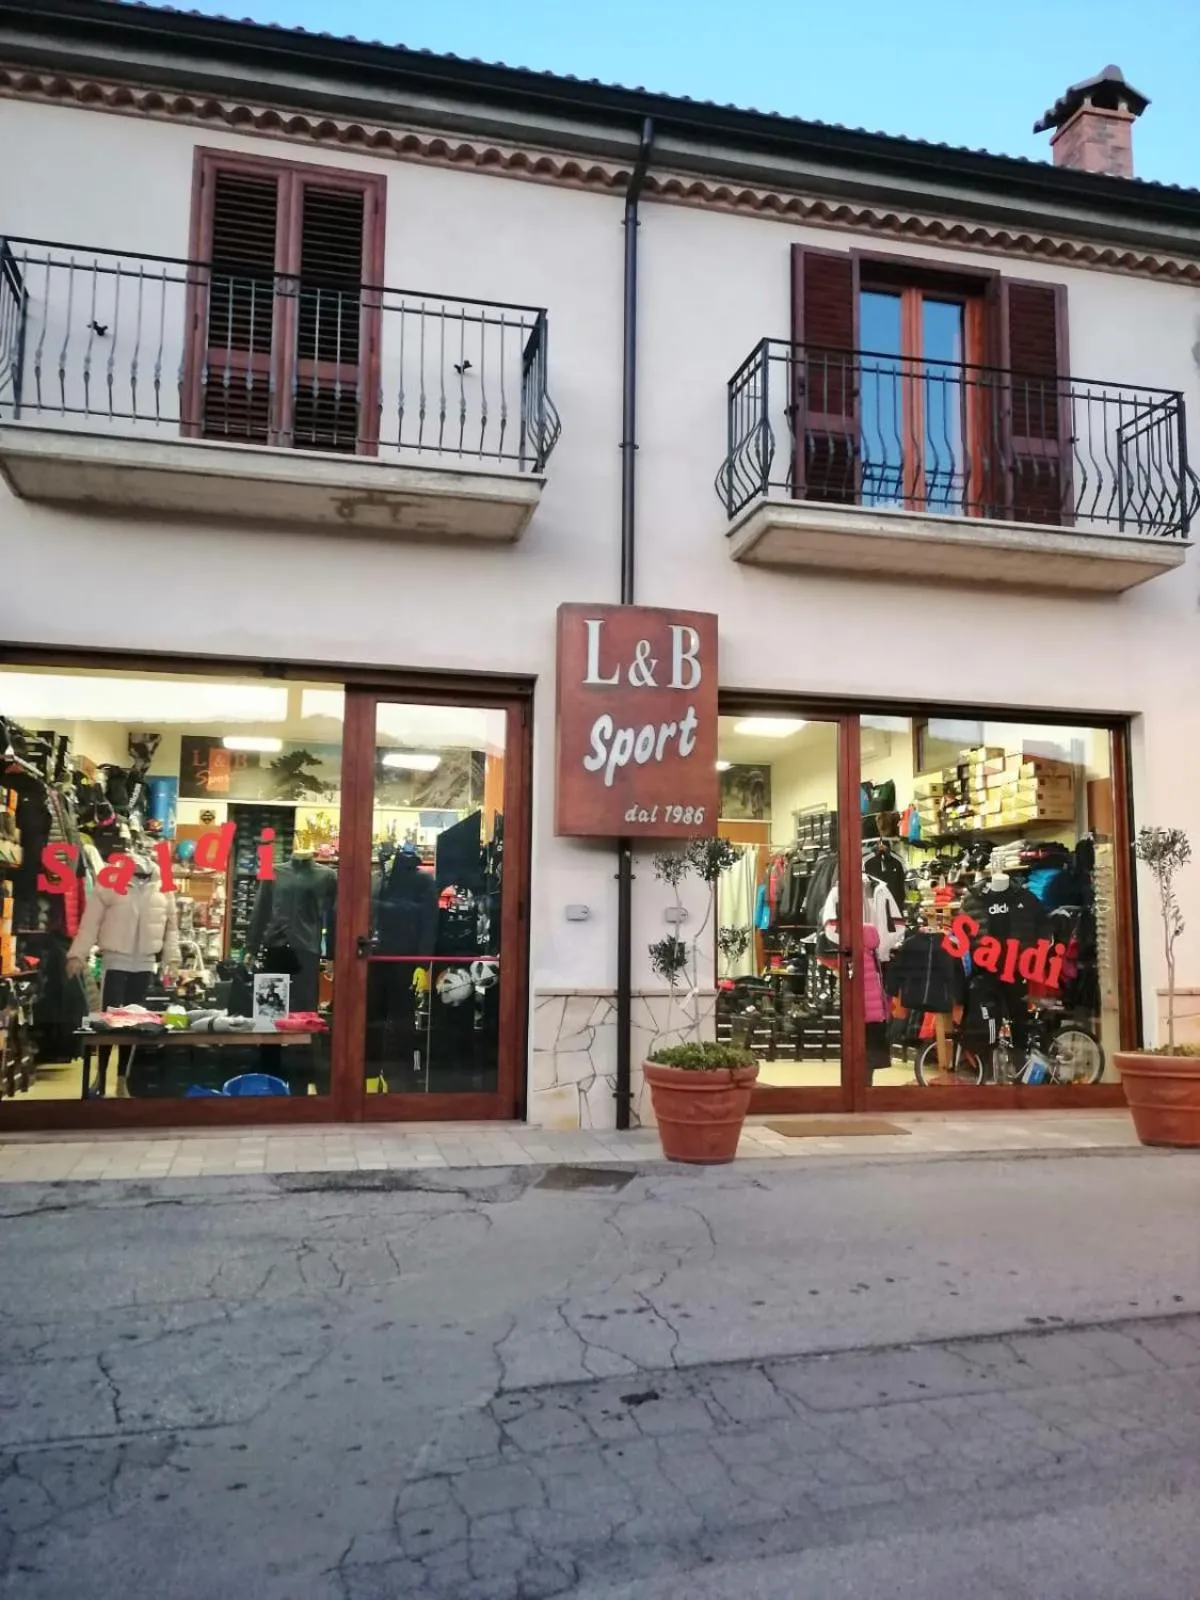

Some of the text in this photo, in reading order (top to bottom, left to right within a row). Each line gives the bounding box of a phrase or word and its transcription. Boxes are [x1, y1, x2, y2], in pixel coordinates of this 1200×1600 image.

[583, 706, 698, 787] Sport
[624, 804, 705, 825] dal 1986
[37, 821, 276, 896] Saldi
[940, 913, 1066, 989] Saldi
